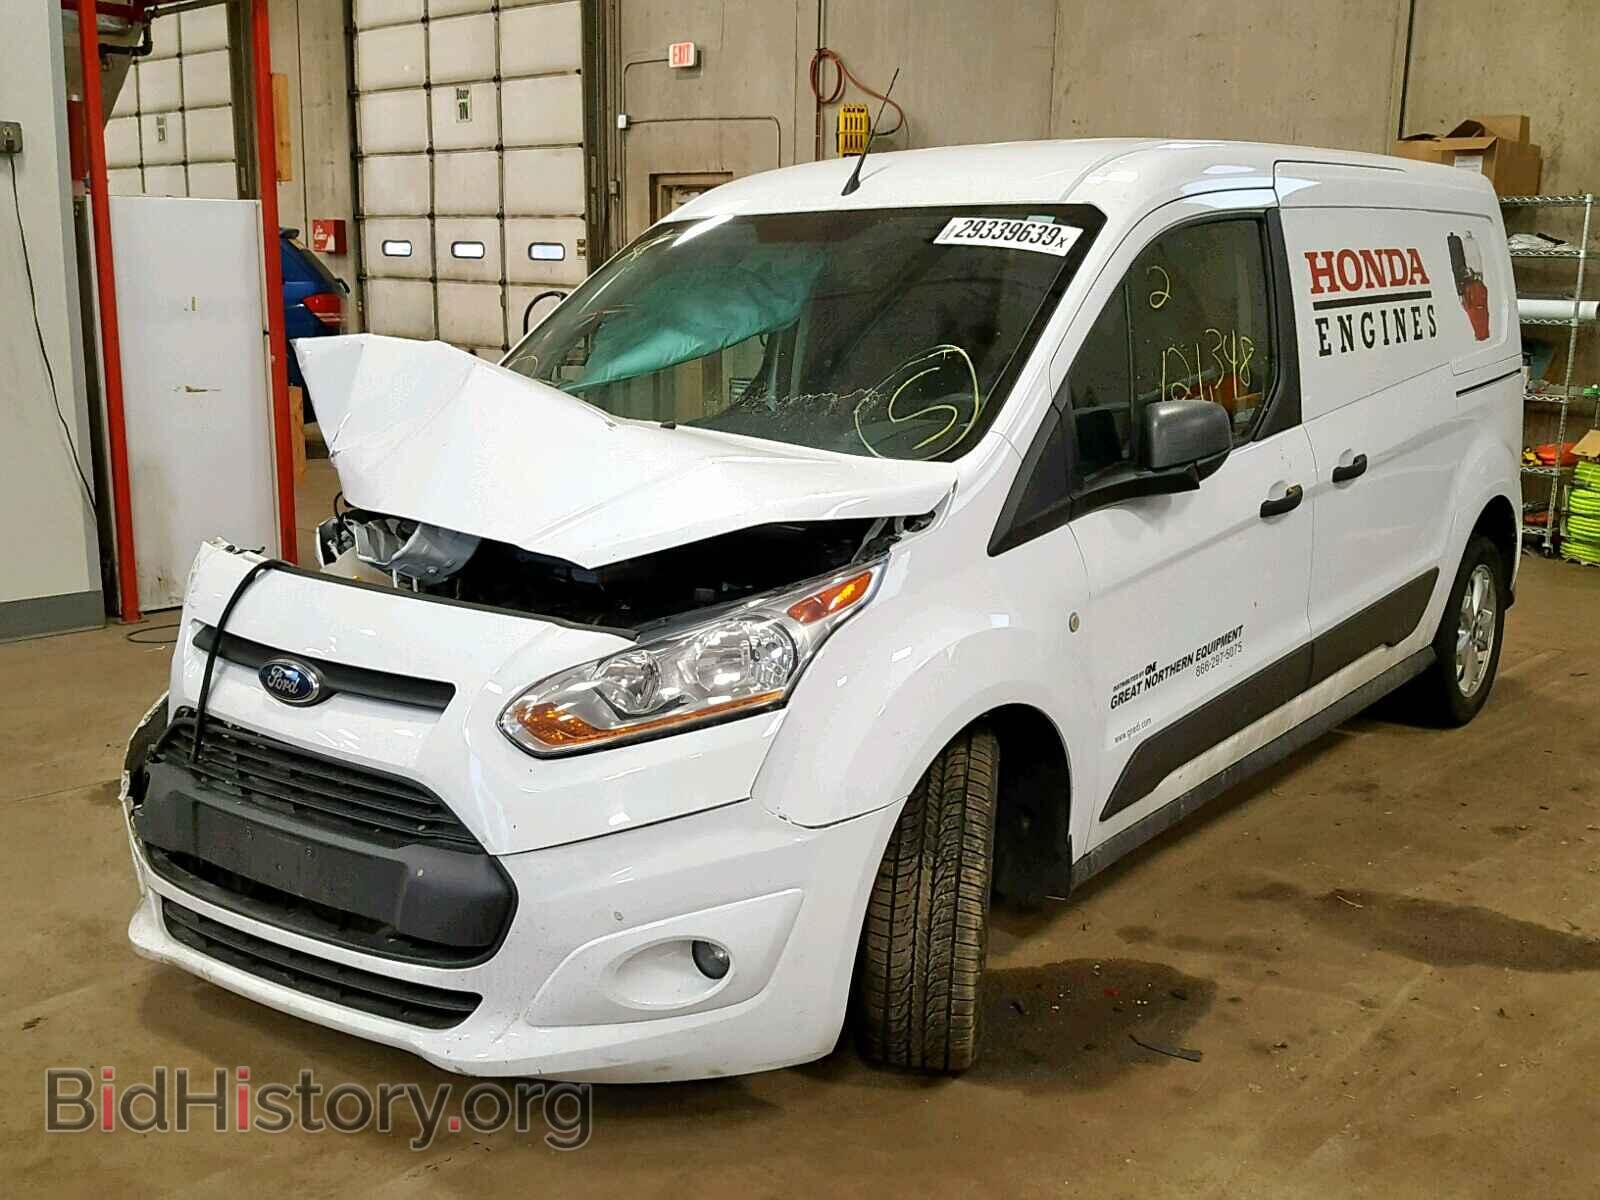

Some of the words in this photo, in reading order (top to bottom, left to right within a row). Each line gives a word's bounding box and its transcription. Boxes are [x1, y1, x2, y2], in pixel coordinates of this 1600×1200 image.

[1304, 248, 1430, 294] HONDA
[1315, 304, 1437, 357] ENGINES
[267, 665, 300, 694] Ford
[1110, 680, 1142, 710] GREAT
[1144, 652, 1194, 692] NORTHERN
[1195, 624, 1244, 662] EQUIPMENT
